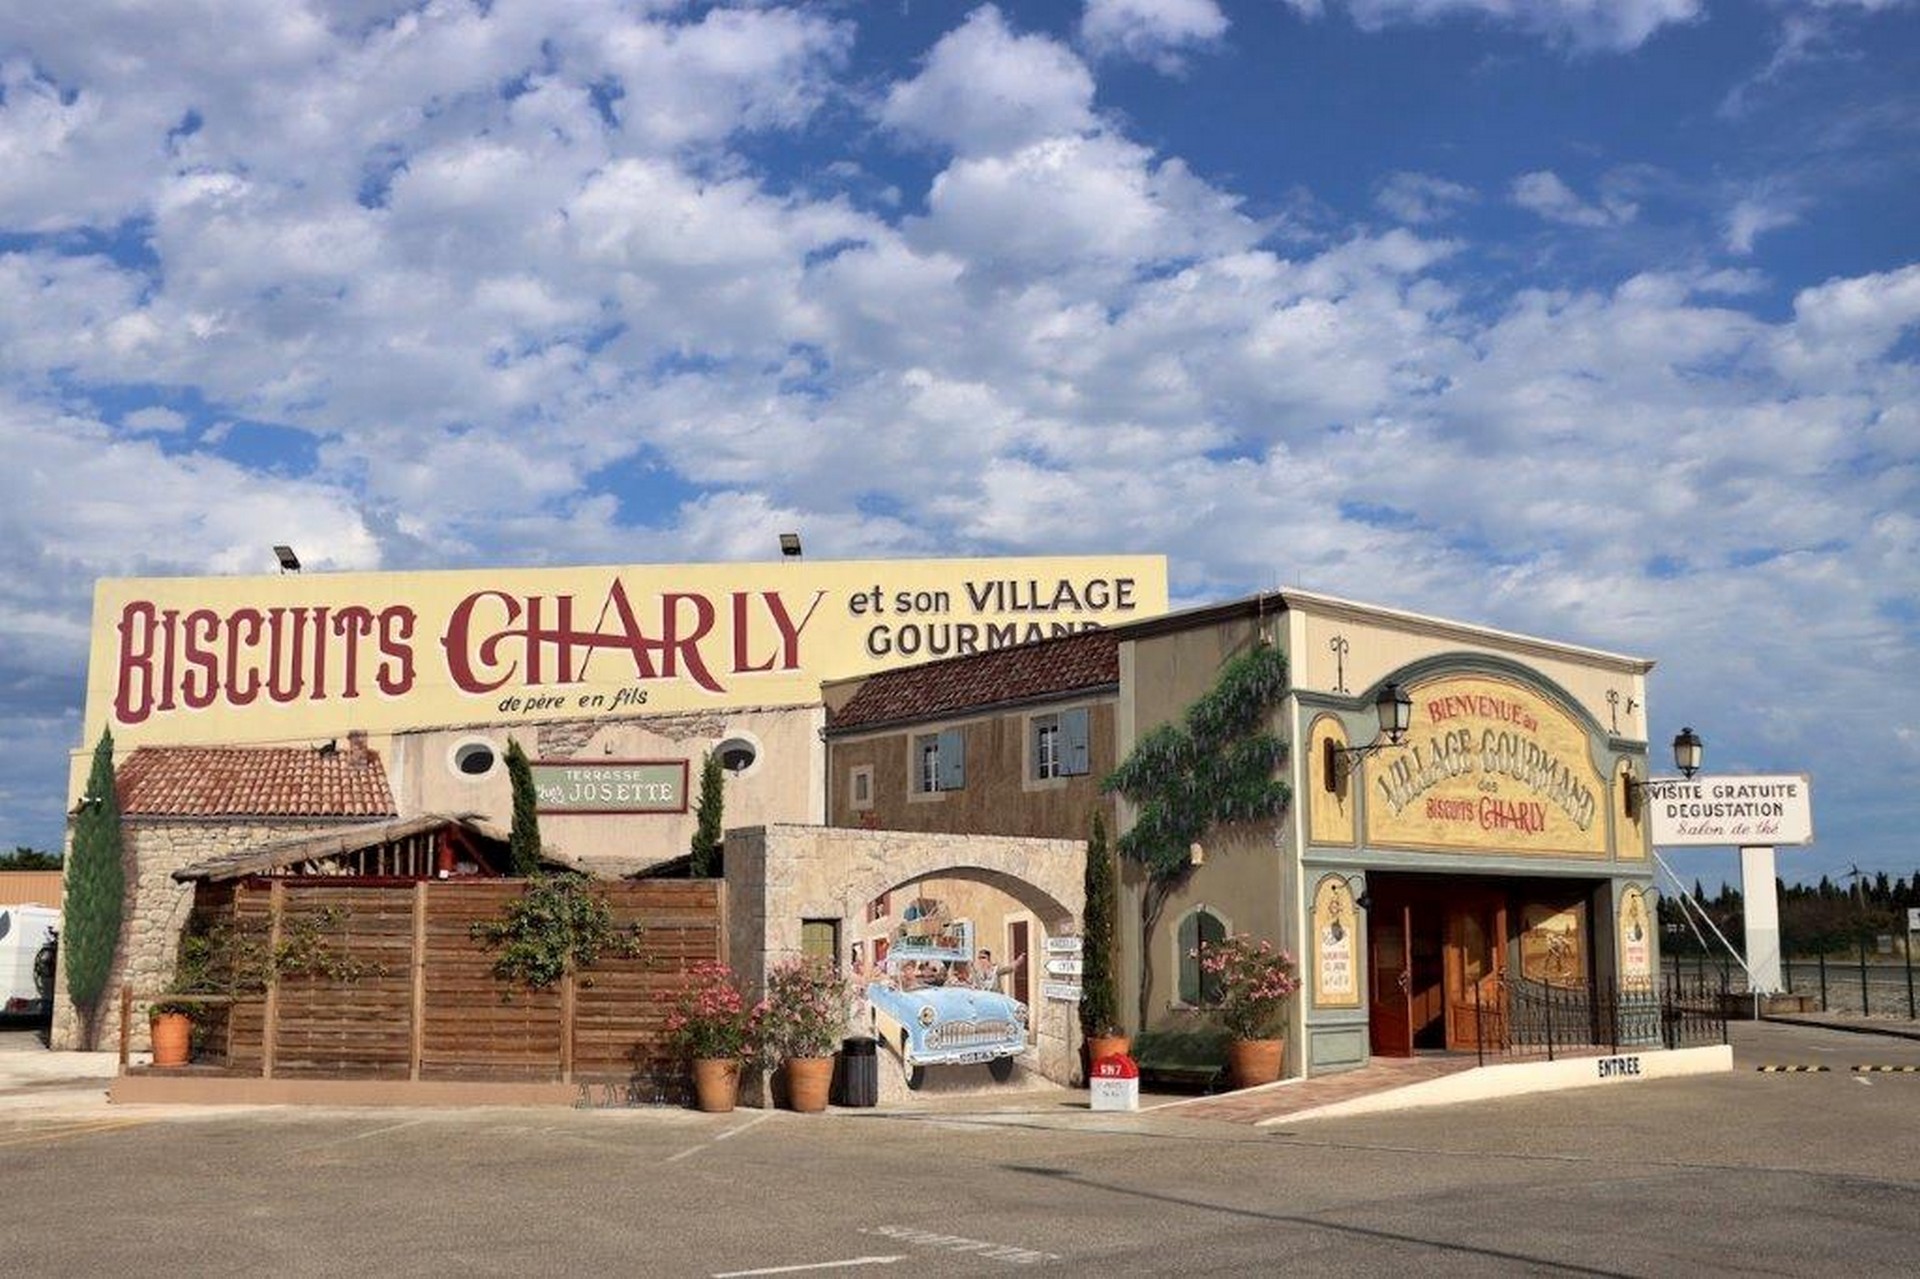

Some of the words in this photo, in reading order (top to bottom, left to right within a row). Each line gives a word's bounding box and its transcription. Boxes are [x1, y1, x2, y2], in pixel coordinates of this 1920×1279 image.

[850, 585, 884, 613] et
[896, 590, 950, 613] son
[966, 578, 1136, 612] VILLAGE
[114, 600, 417, 724] BISCUITS
[440, 576, 828, 693] CHARLY
[498, 696, 521, 712] de
[523, 693, 565, 714] père
[578, 695, 604, 707] en
[607, 687, 648, 711] fils
[1428, 694, 1522, 725] BIENVENUE
[566, 769, 643, 782] TERRASSE
[1377, 728, 1472, 817] VILLAGE
[1479, 728, 1595, 832] GOURMAND
[568, 783, 673, 802] JOSETTE
[1651, 785, 1702, 800] VISITE
[1712, 784, 1797, 798] GRATUITE
[1426, 798, 1475, 821] BISCUITS
[1478, 796, 1548, 835] CHARLY
[1677, 820, 1724, 836] Salon
[1731, 820, 1750, 835] de
[1598, 1057, 1640, 1078] ENTREE
